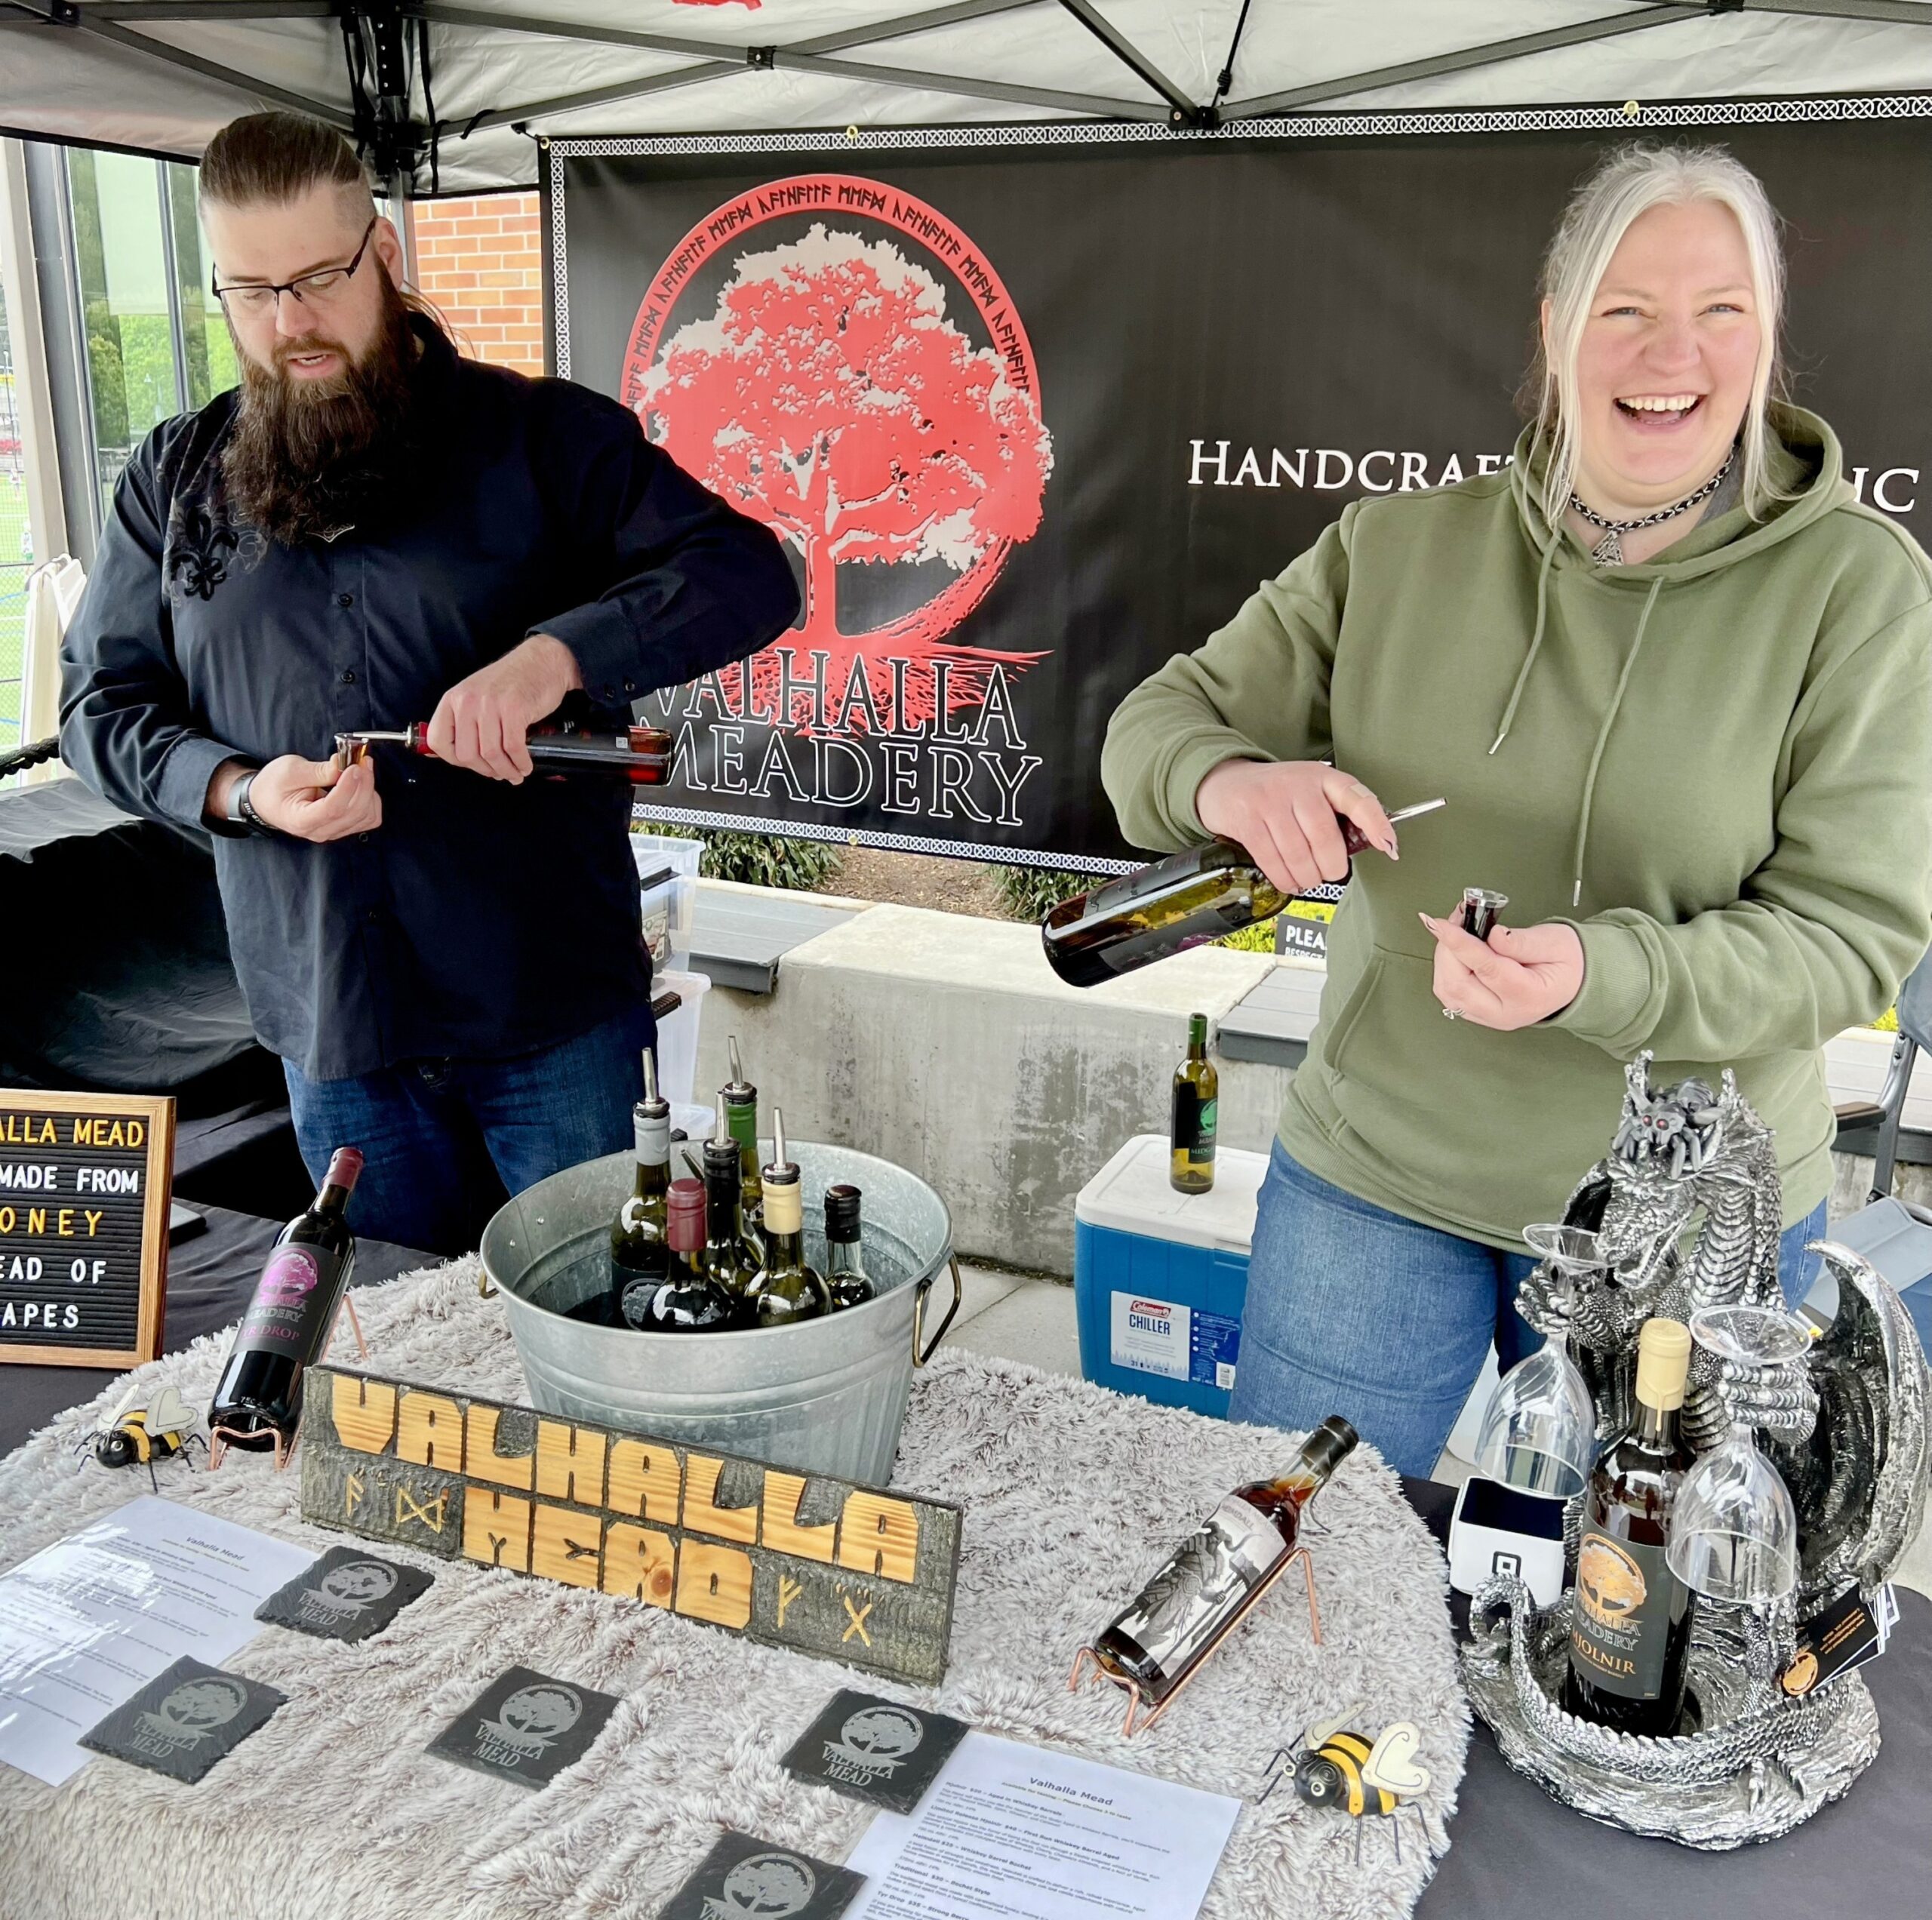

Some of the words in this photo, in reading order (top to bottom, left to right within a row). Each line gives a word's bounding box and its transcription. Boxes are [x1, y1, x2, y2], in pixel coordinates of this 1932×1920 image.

[1188, 440, 1514, 491] HANDCRAF
[1285, 925, 1327, 951] PLEA
[73, 1118, 144, 1147] MEAD
[0, 1164, 58, 1190] MADE
[76, 1168, 140, 1194] FROM
[70, 1258, 107, 1285] OF
[1, 1302, 79, 1329] APES
[1132, 1302, 1163, 1315] Coleman
[260, 1325, 300, 1340] DROP
[1129, 1314, 1171, 1336] CHILLER
[332, 1373, 920, 1584] VALHALLA
[186, 1537, 220, 1552] Valhalla
[220, 1548, 246, 1561] Mead
[294, 1605, 338, 1627] MEAD
[1572, 1628, 1637, 1675] MJOLNIR
[125, 1734, 175, 1758] MEAD
[471, 1740, 521, 1768] MEAD
[474, 1723, 545, 1760] VALHALLA
[821, 1745, 894, 1780] VALHALLA
[823, 1762, 873, 1787] MEAD
[1027, 1777, 1078, 1795] Valhalla
[1079, 1791, 1115, 1805] Mead
